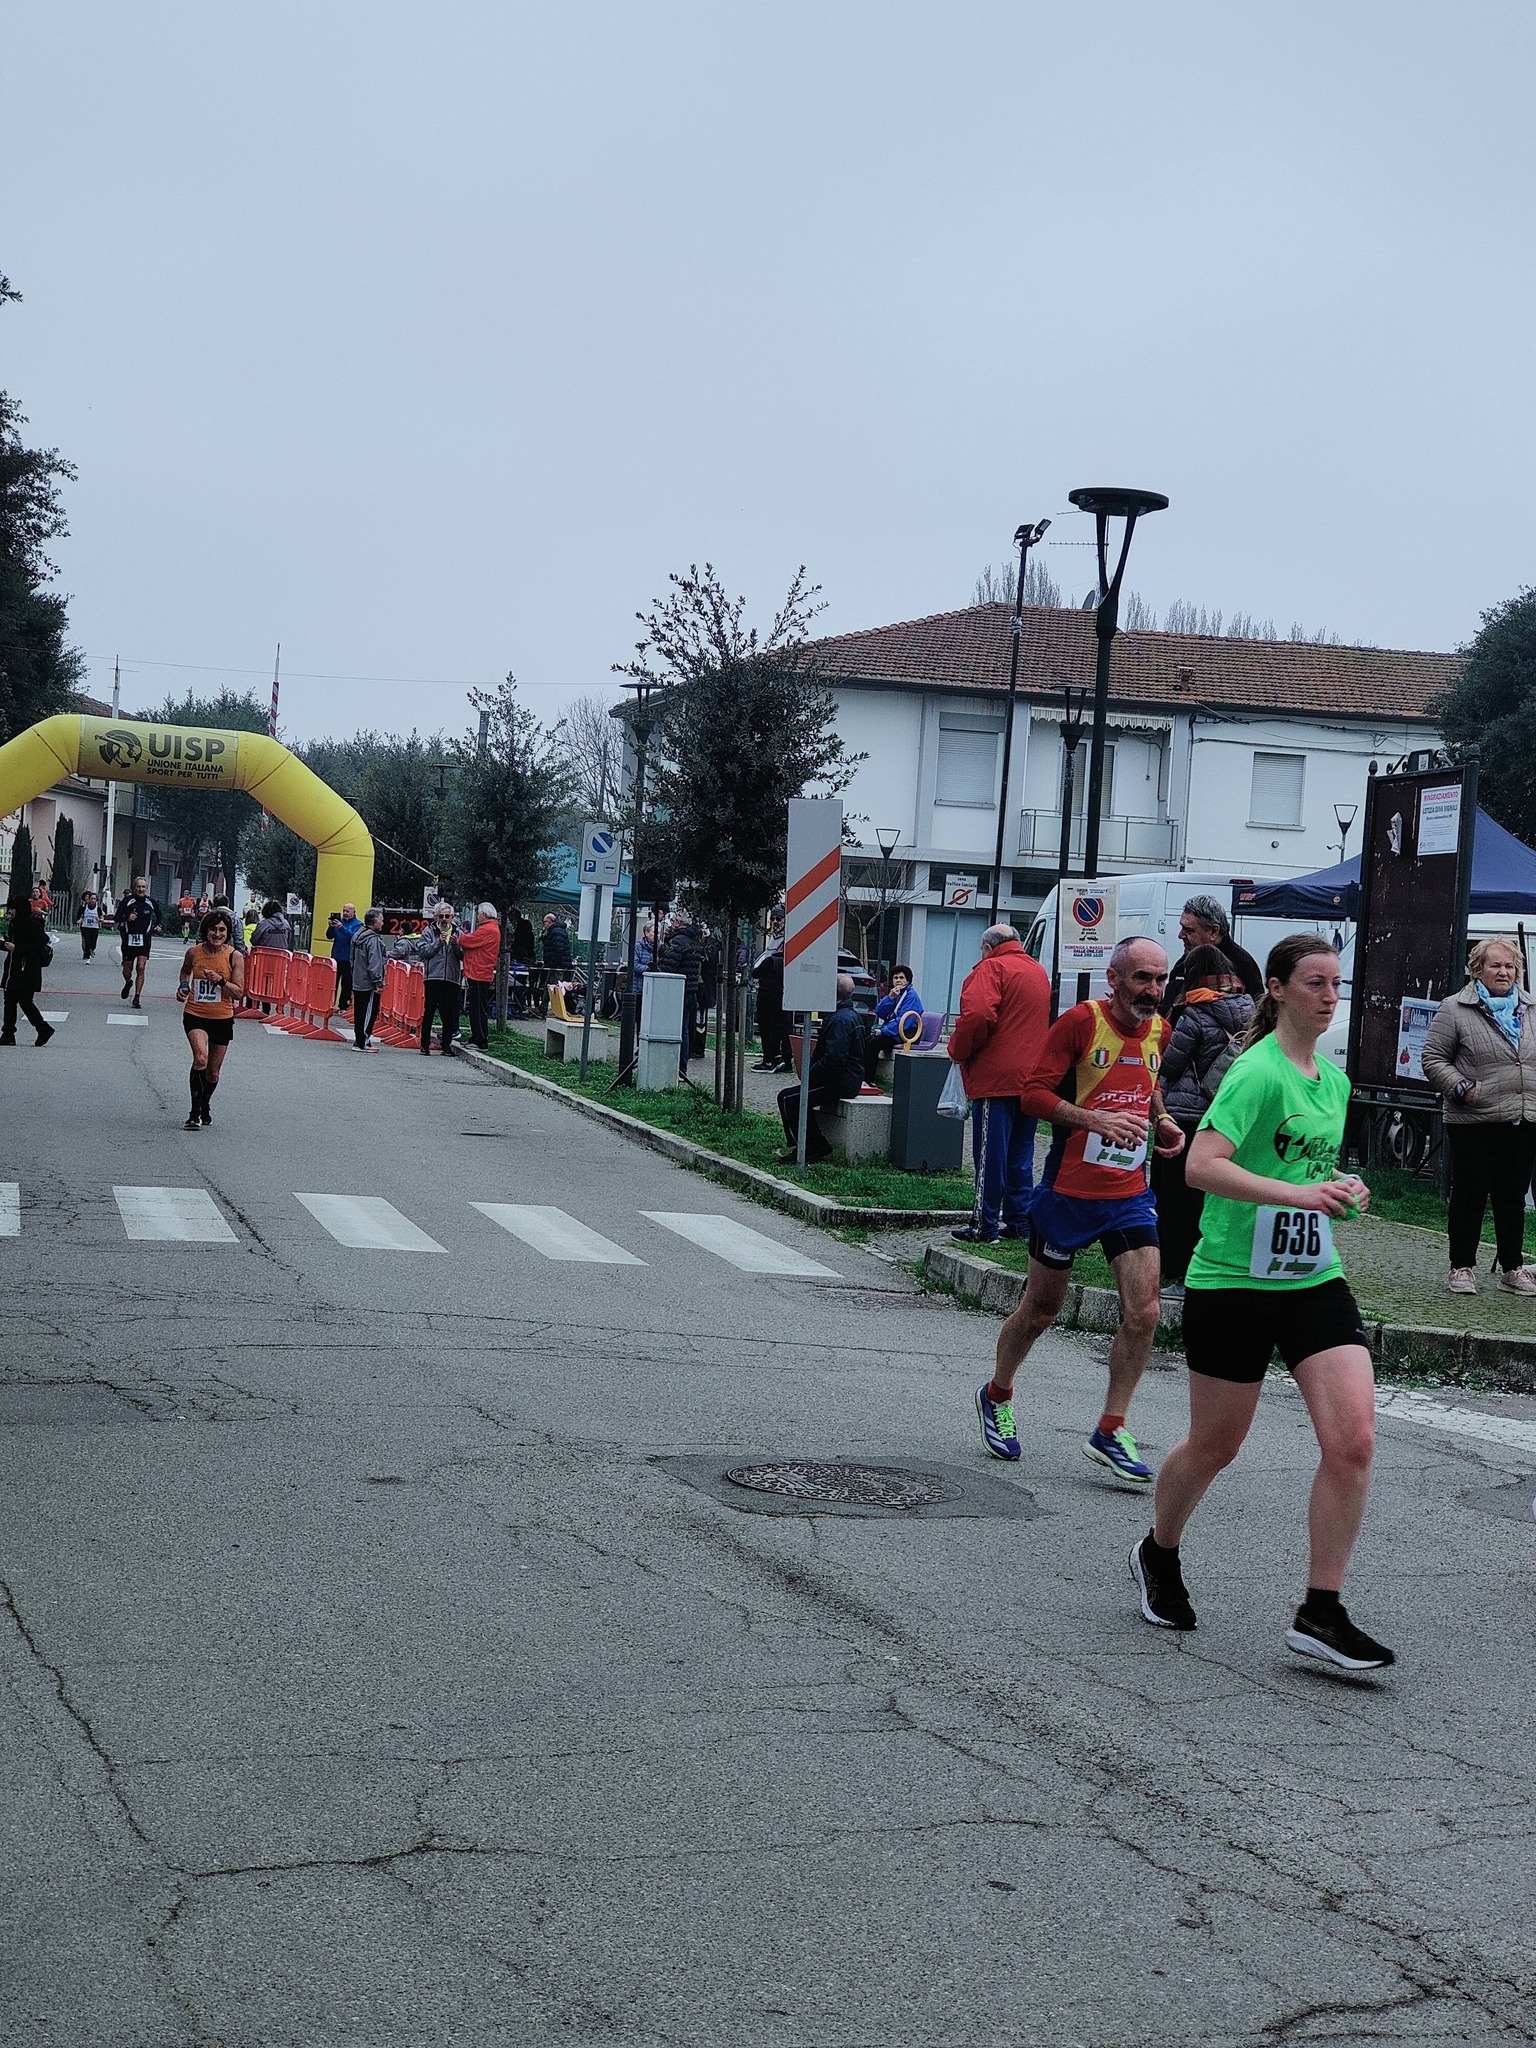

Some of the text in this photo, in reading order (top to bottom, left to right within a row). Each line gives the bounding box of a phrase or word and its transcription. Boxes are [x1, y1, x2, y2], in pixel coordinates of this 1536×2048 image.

[148, 732, 225, 762] UISP
[147, 759, 224, 773] UNIONE ITALIANA
[146, 767, 219, 780] SPORT PER TUTTI
[586, 862, 595, 871] P
[199, 980, 216, 995] 612
[1271, 1211, 1321, 1257] 636
